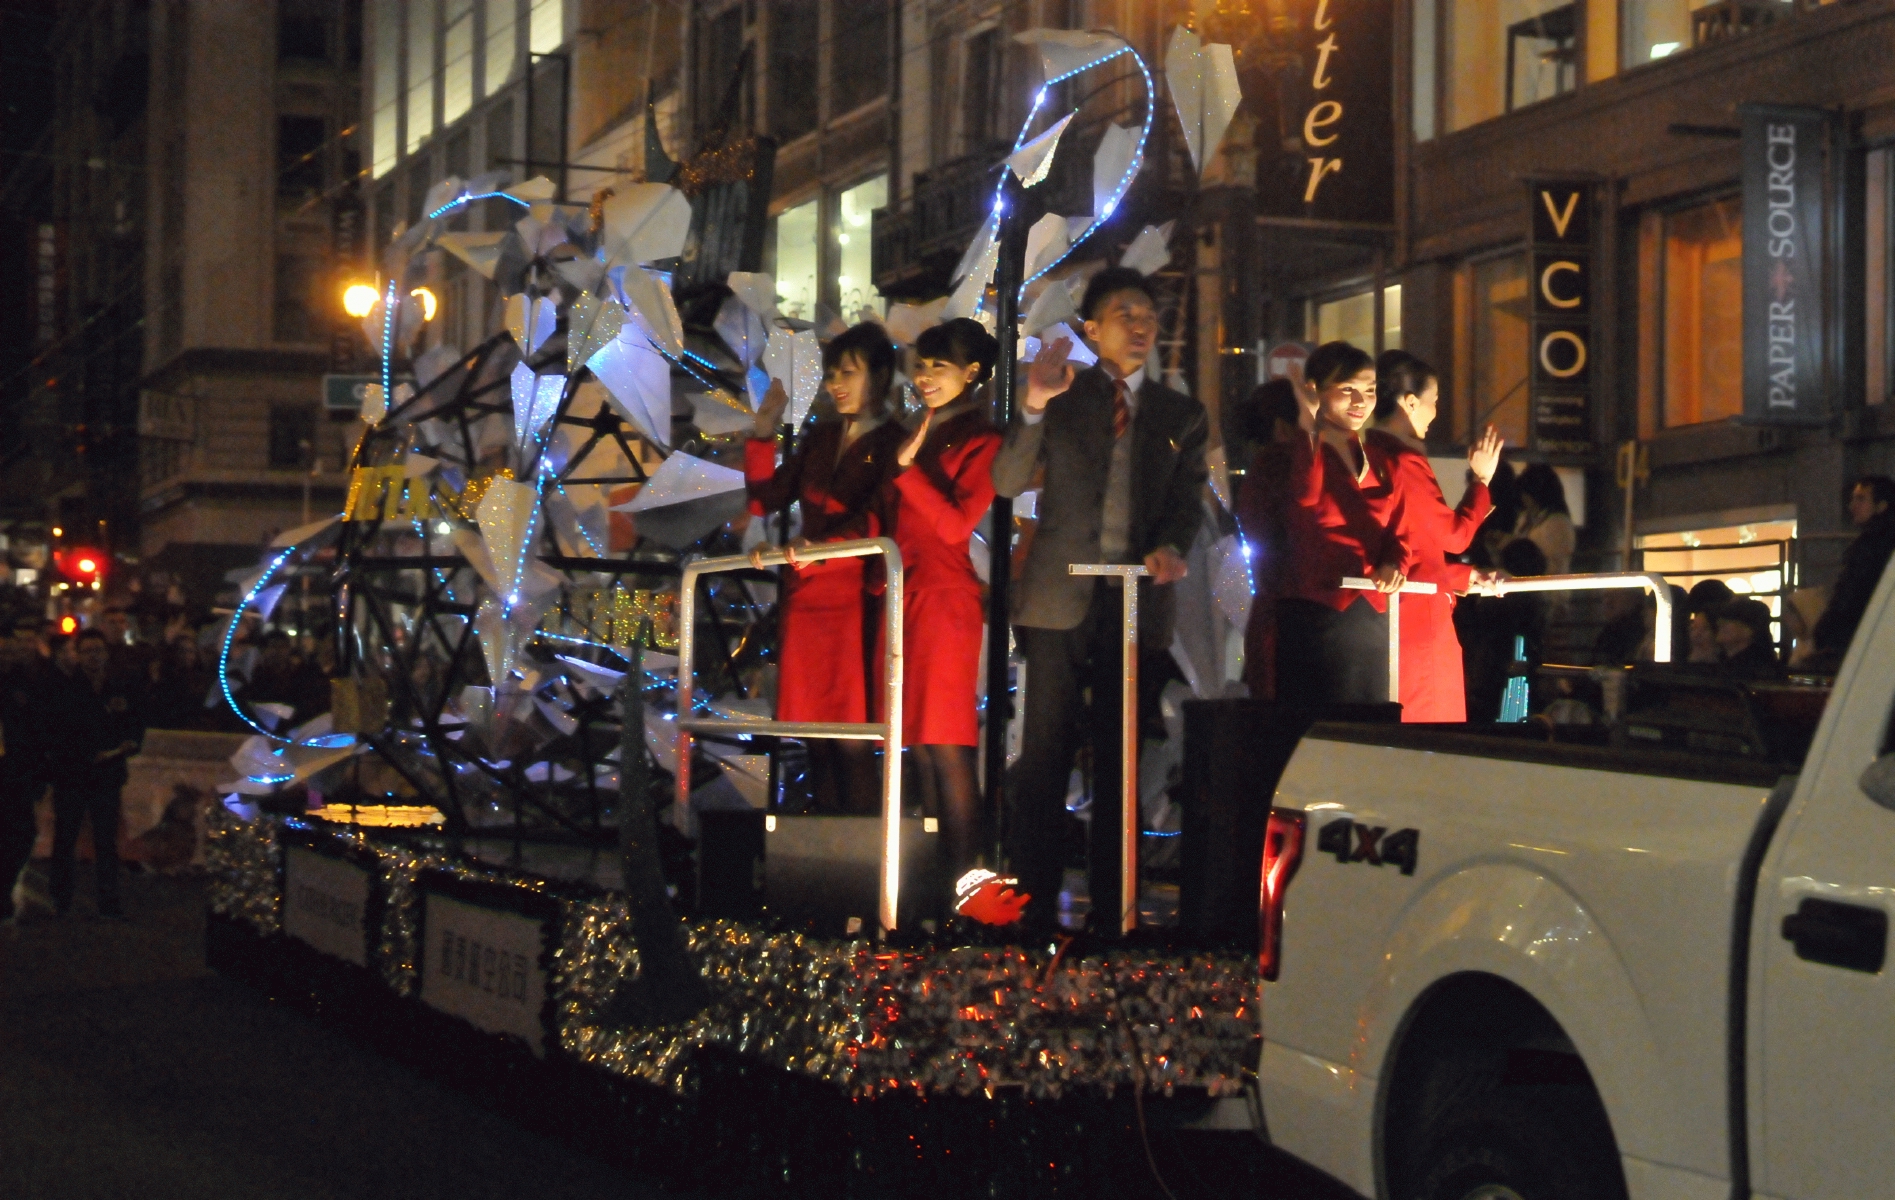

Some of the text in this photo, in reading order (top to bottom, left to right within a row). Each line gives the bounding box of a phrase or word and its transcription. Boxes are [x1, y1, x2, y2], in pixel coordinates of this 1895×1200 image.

[1540, 190, 1587, 378] VCO
[1766, 123, 1797, 410] PAPER SOURCE
